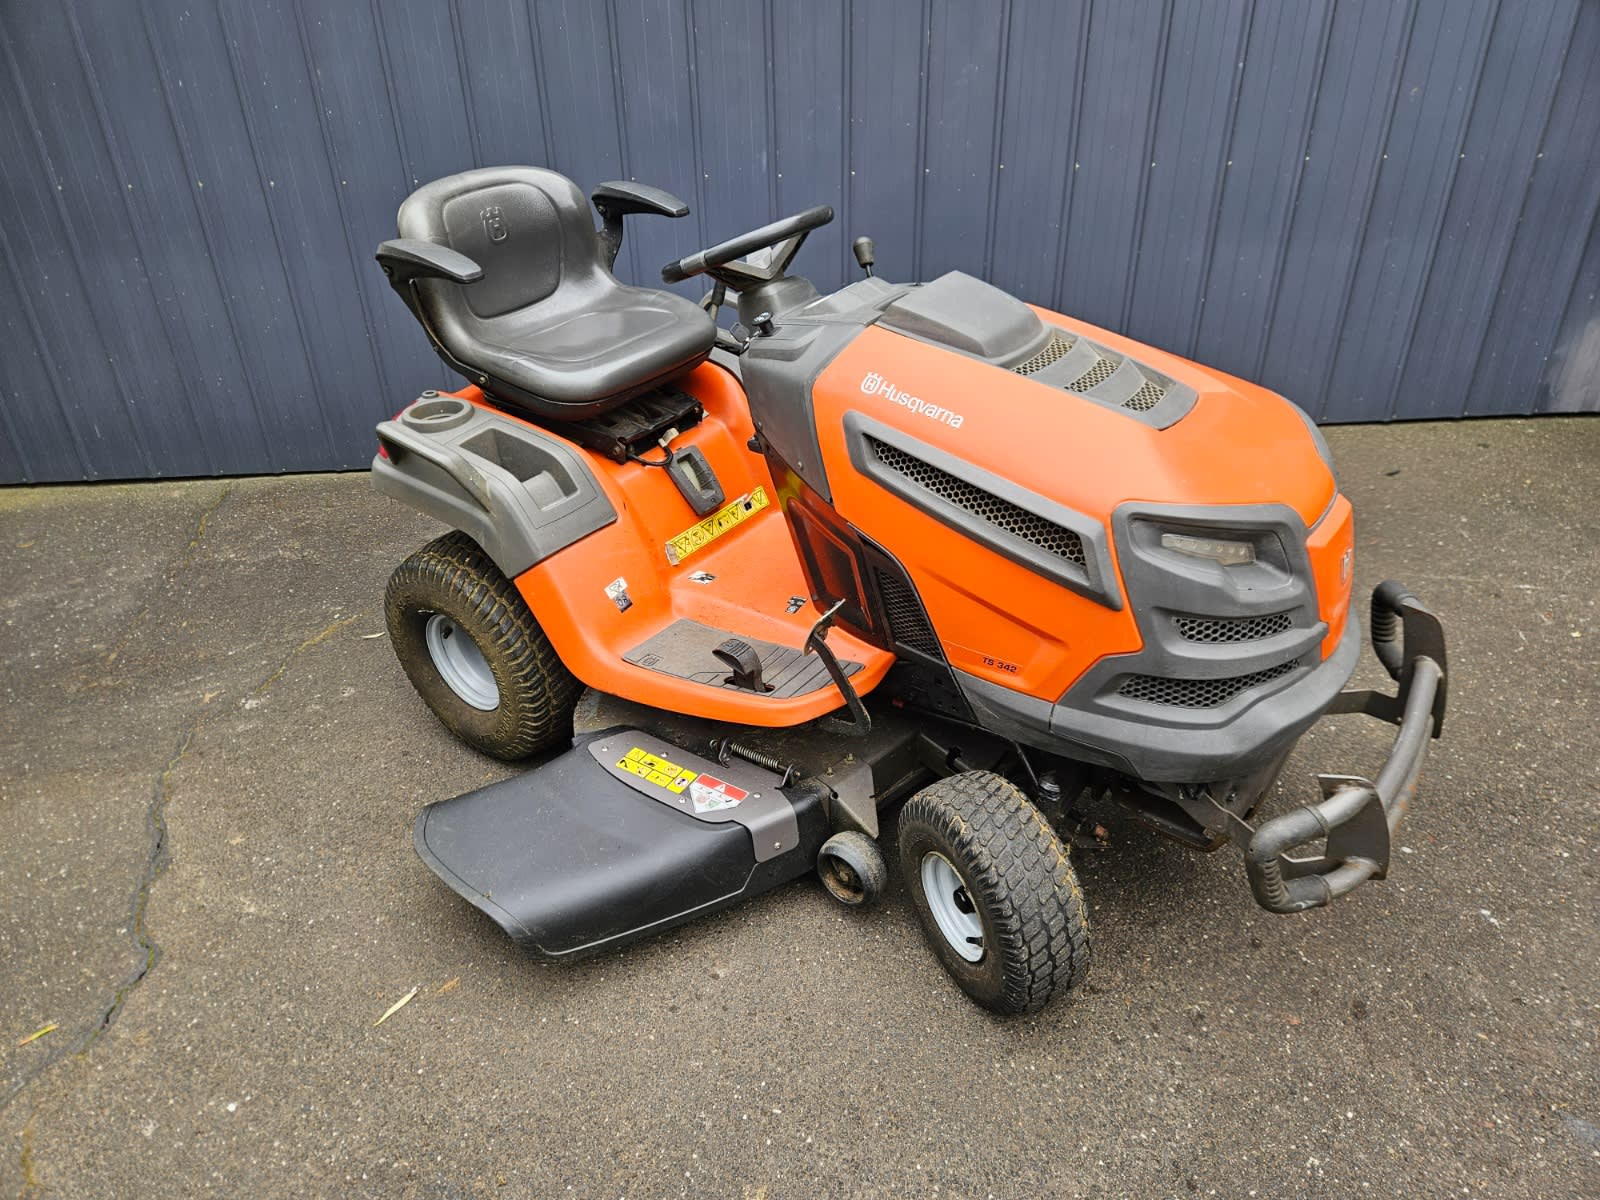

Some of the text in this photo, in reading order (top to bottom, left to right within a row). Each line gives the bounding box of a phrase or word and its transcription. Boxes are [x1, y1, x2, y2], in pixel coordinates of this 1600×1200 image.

[877, 380, 964, 429] Husqvarna
[982, 656, 1017, 673] TS 342
